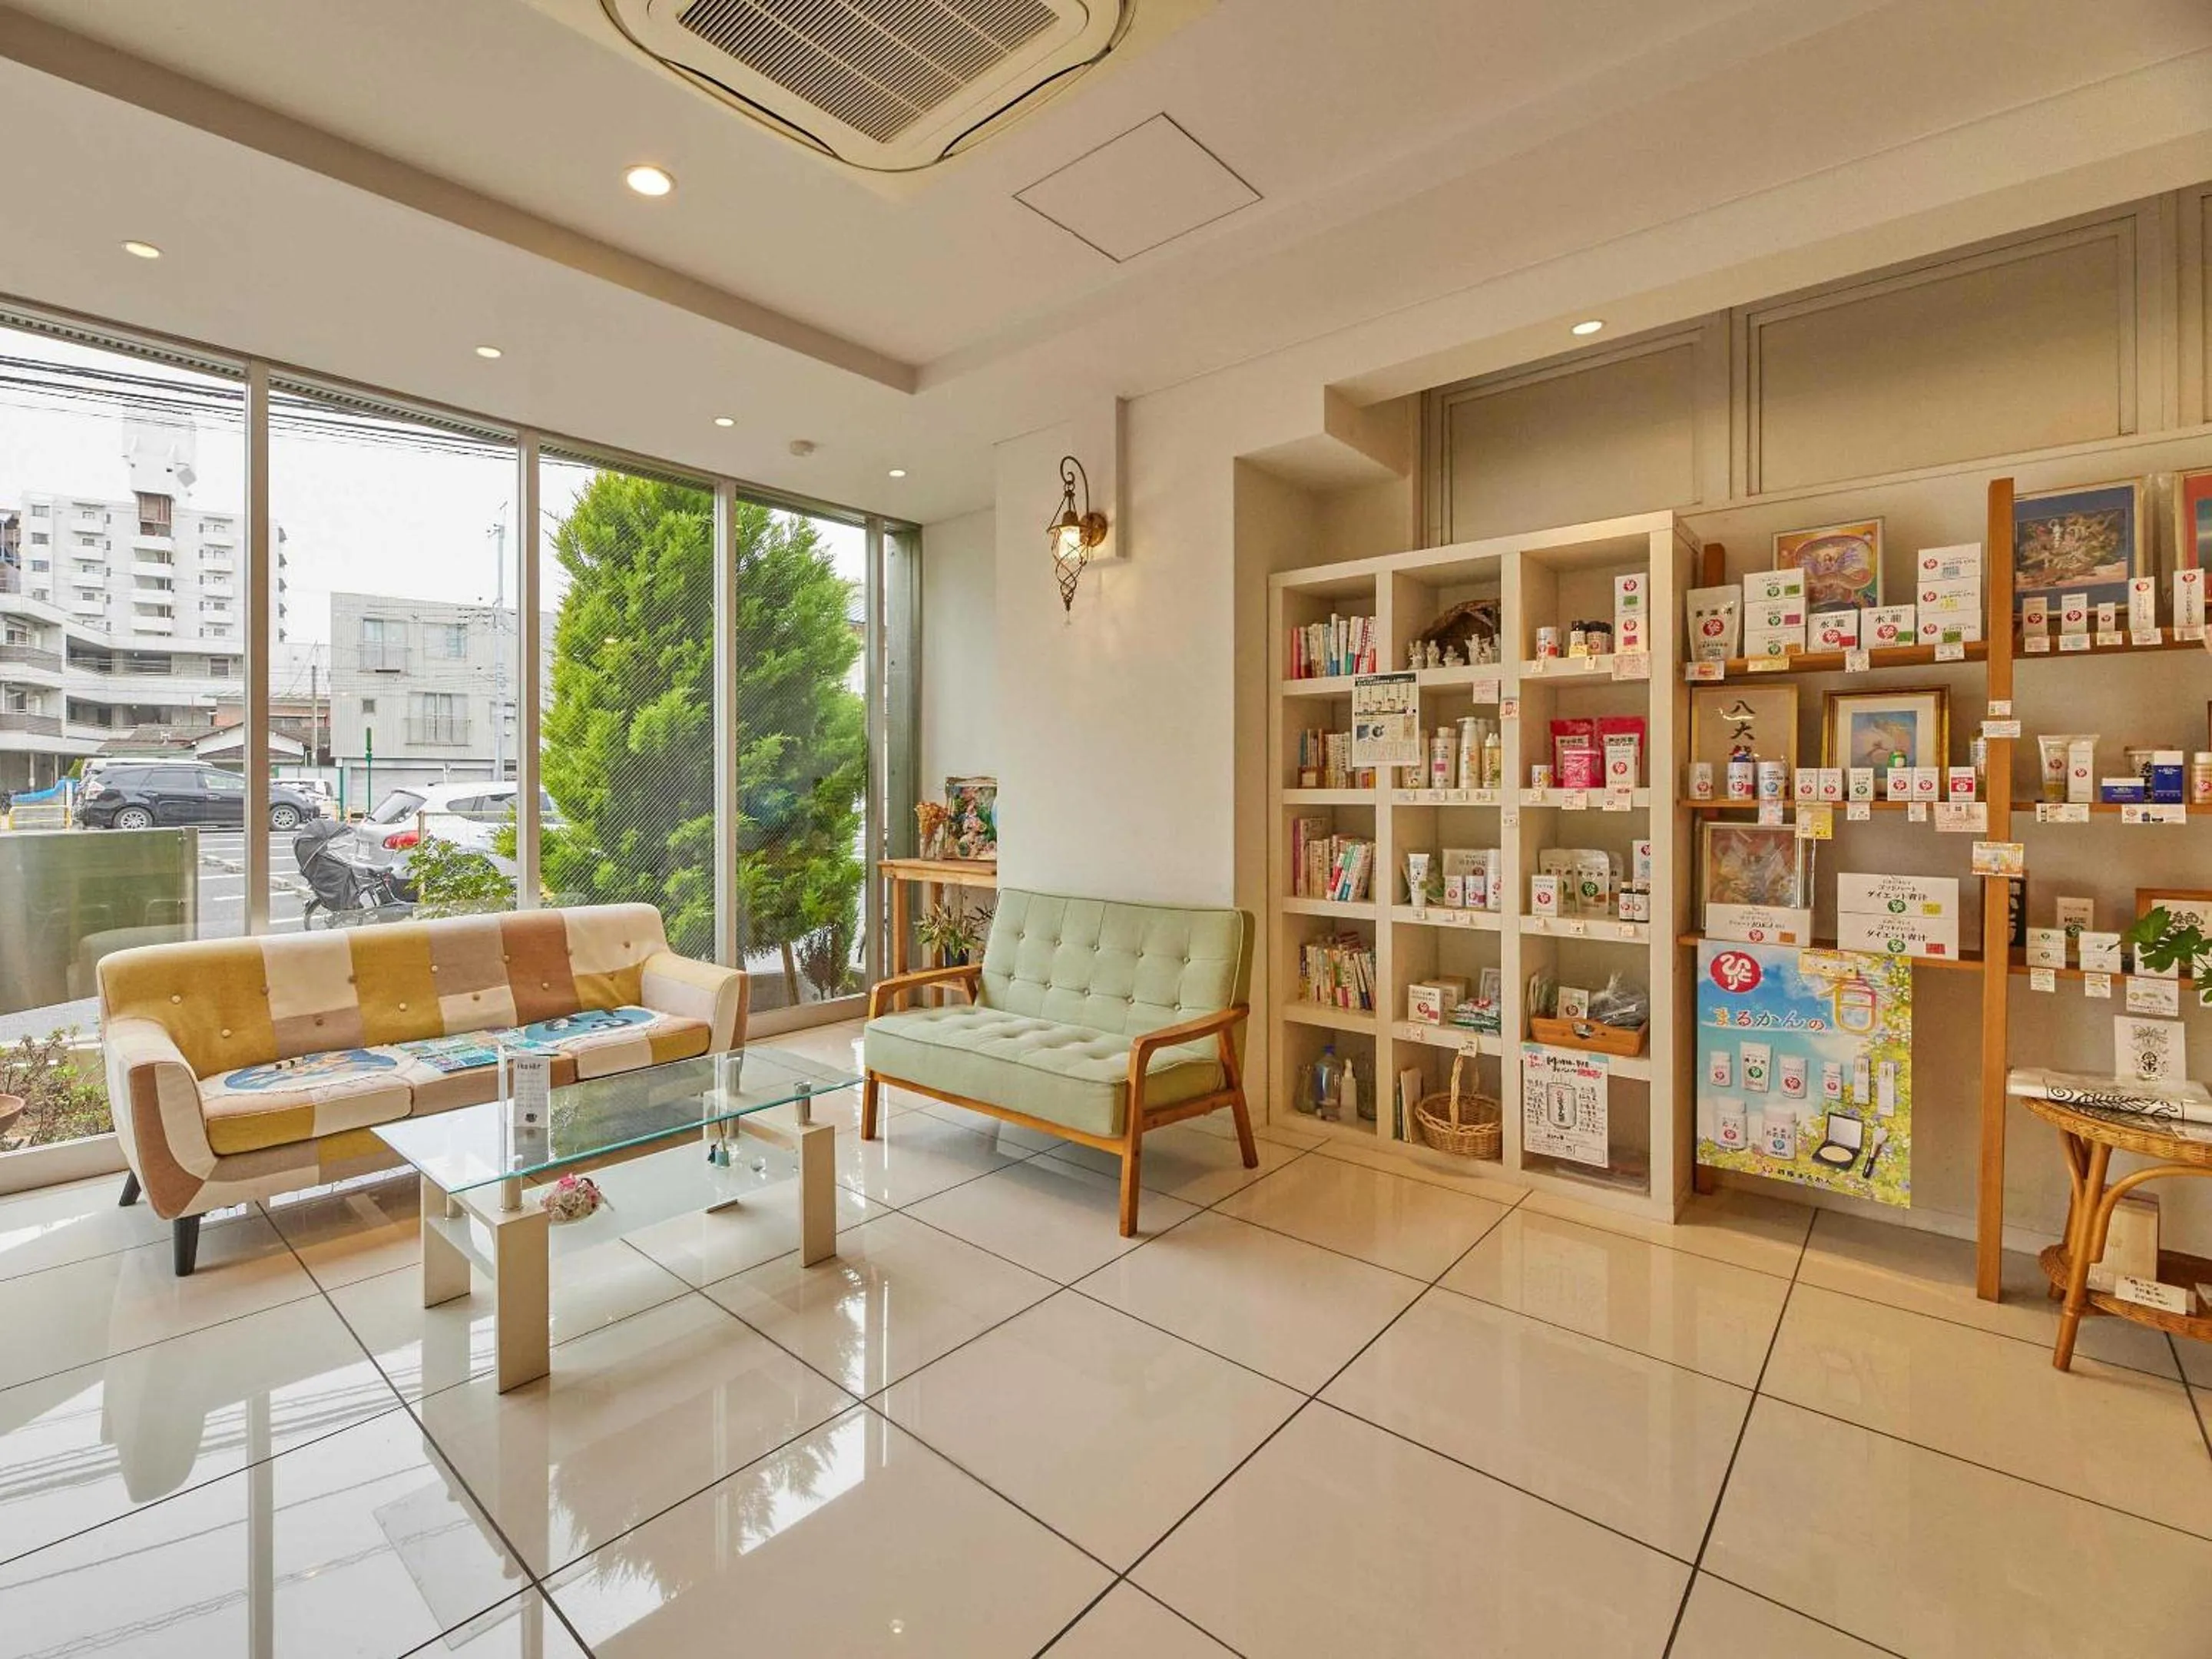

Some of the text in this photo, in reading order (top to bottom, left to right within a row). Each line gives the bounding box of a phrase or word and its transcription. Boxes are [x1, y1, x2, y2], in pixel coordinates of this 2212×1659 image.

[1713, 1005, 1826, 1031] まるかんの
